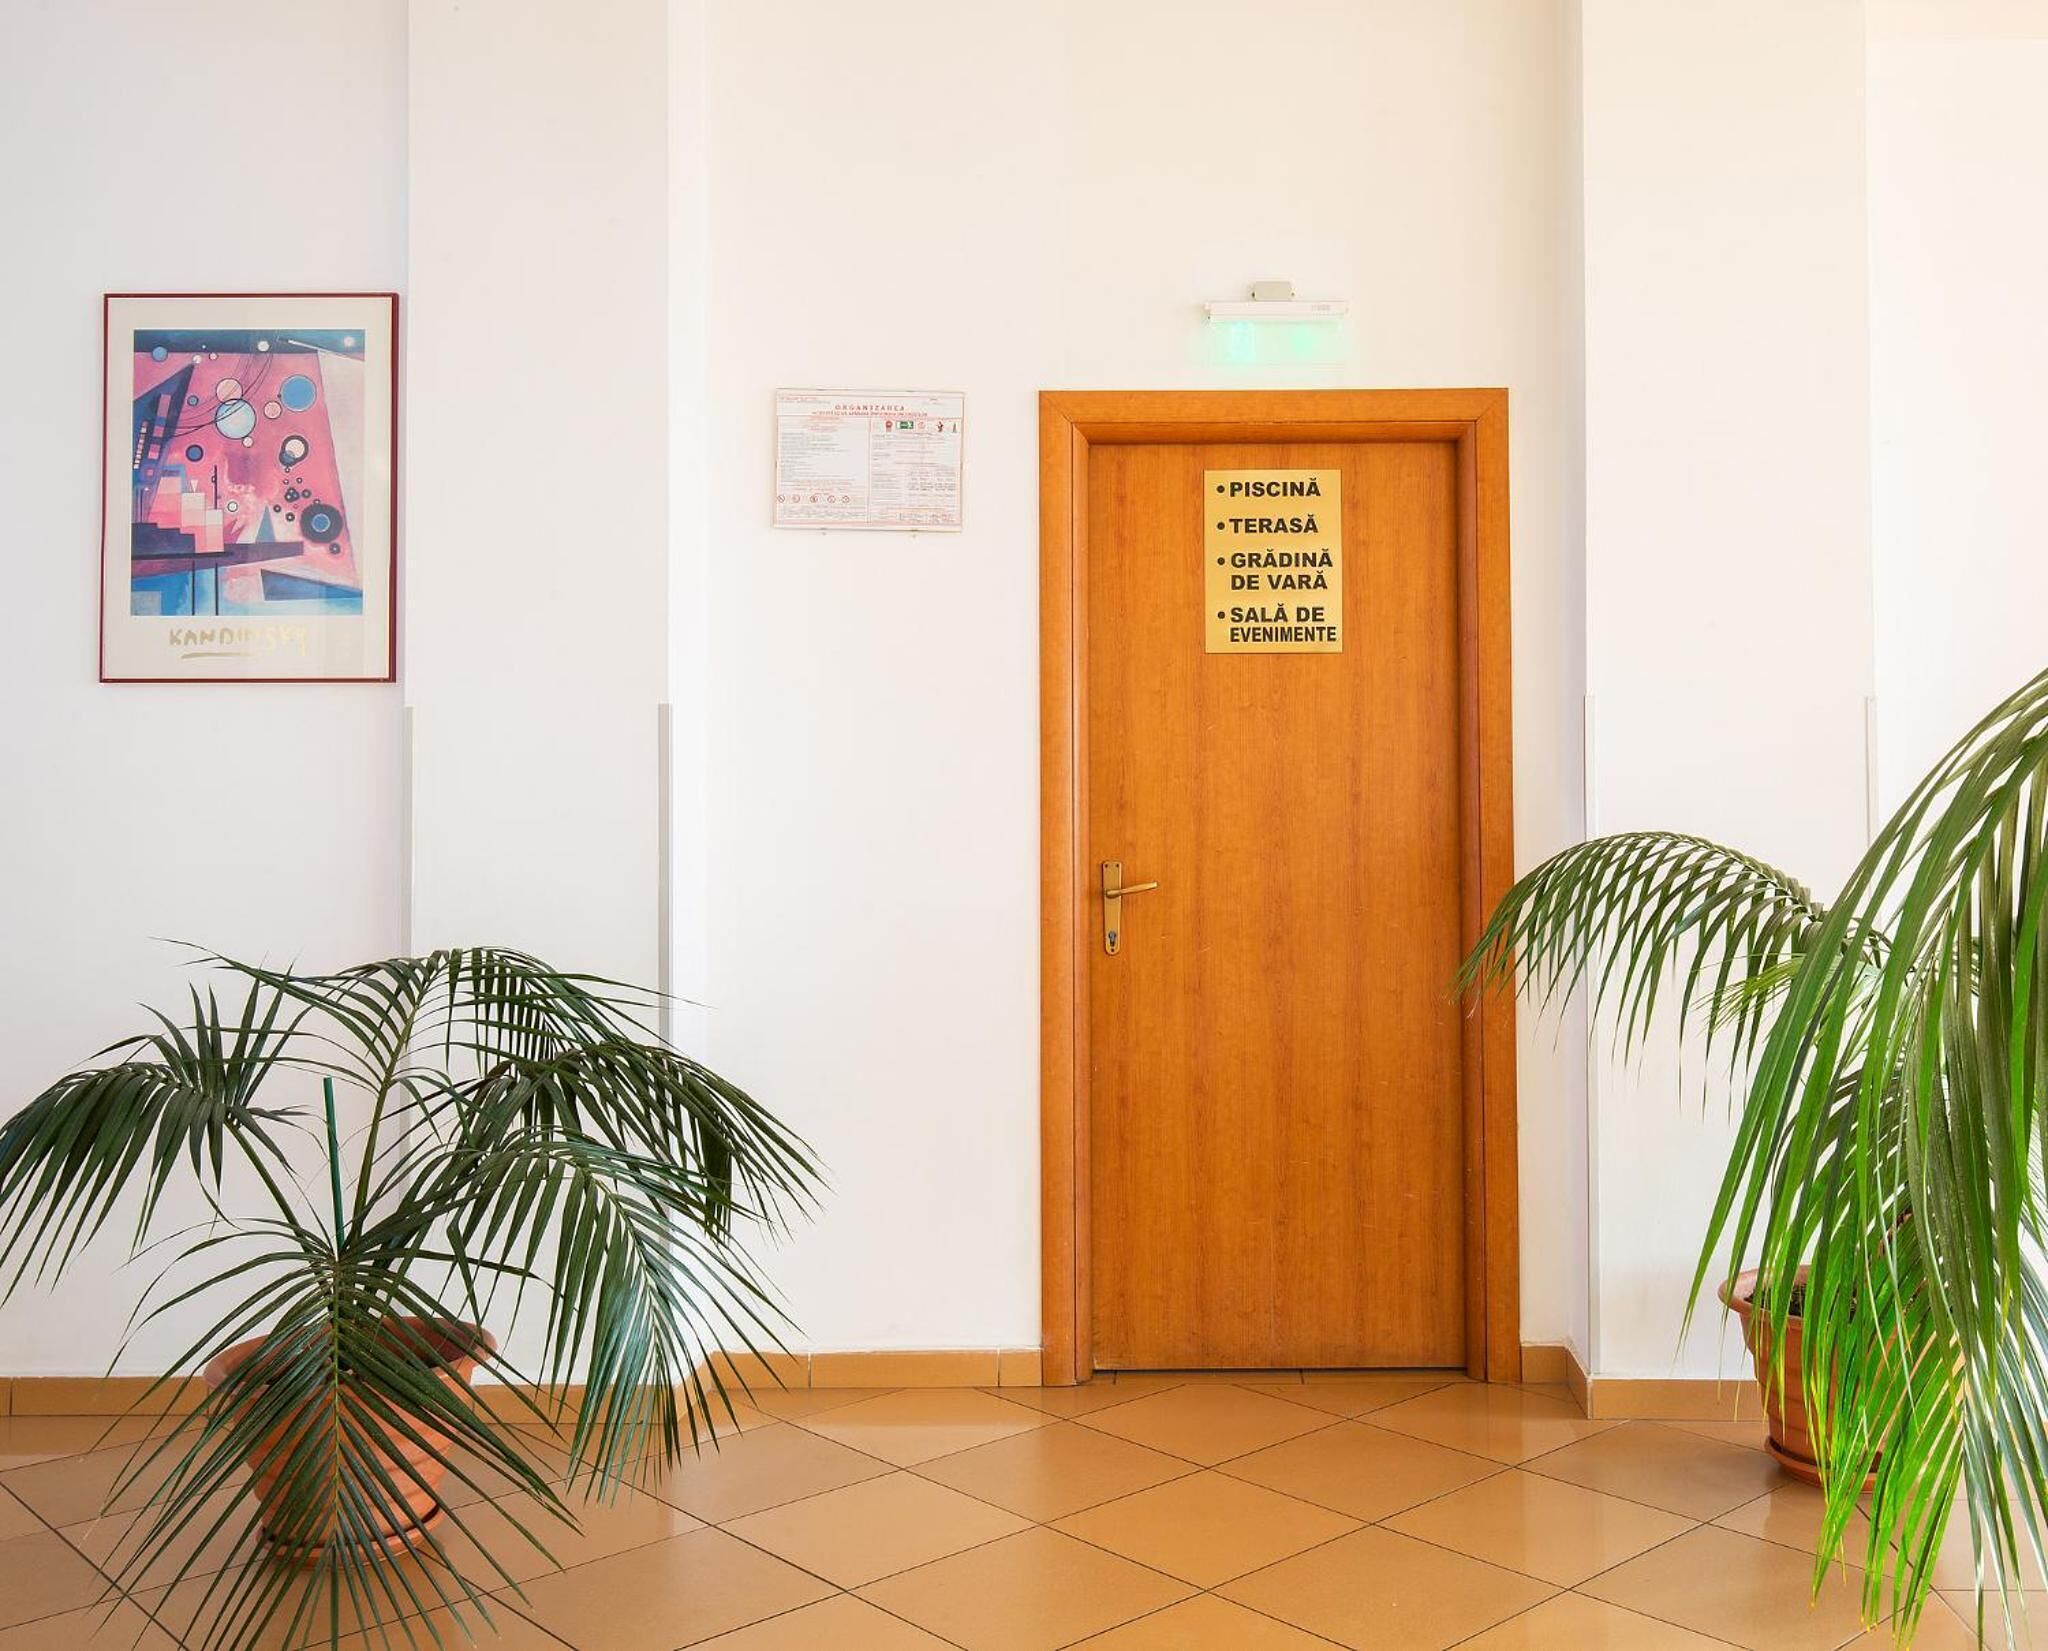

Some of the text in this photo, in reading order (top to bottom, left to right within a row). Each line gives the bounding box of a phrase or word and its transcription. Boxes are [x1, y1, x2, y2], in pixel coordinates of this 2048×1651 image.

[1229, 477, 1321, 498] PISCINĂ
[1229, 513, 1319, 534] TERASĂ
[1230, 548, 1333, 569] GRĂDINĂ
[1231, 570, 1328, 591] DE VARĂ
[1230, 602, 1325, 623] SALĂ DE
[1230, 626, 1337, 643] EVENIMENTE
